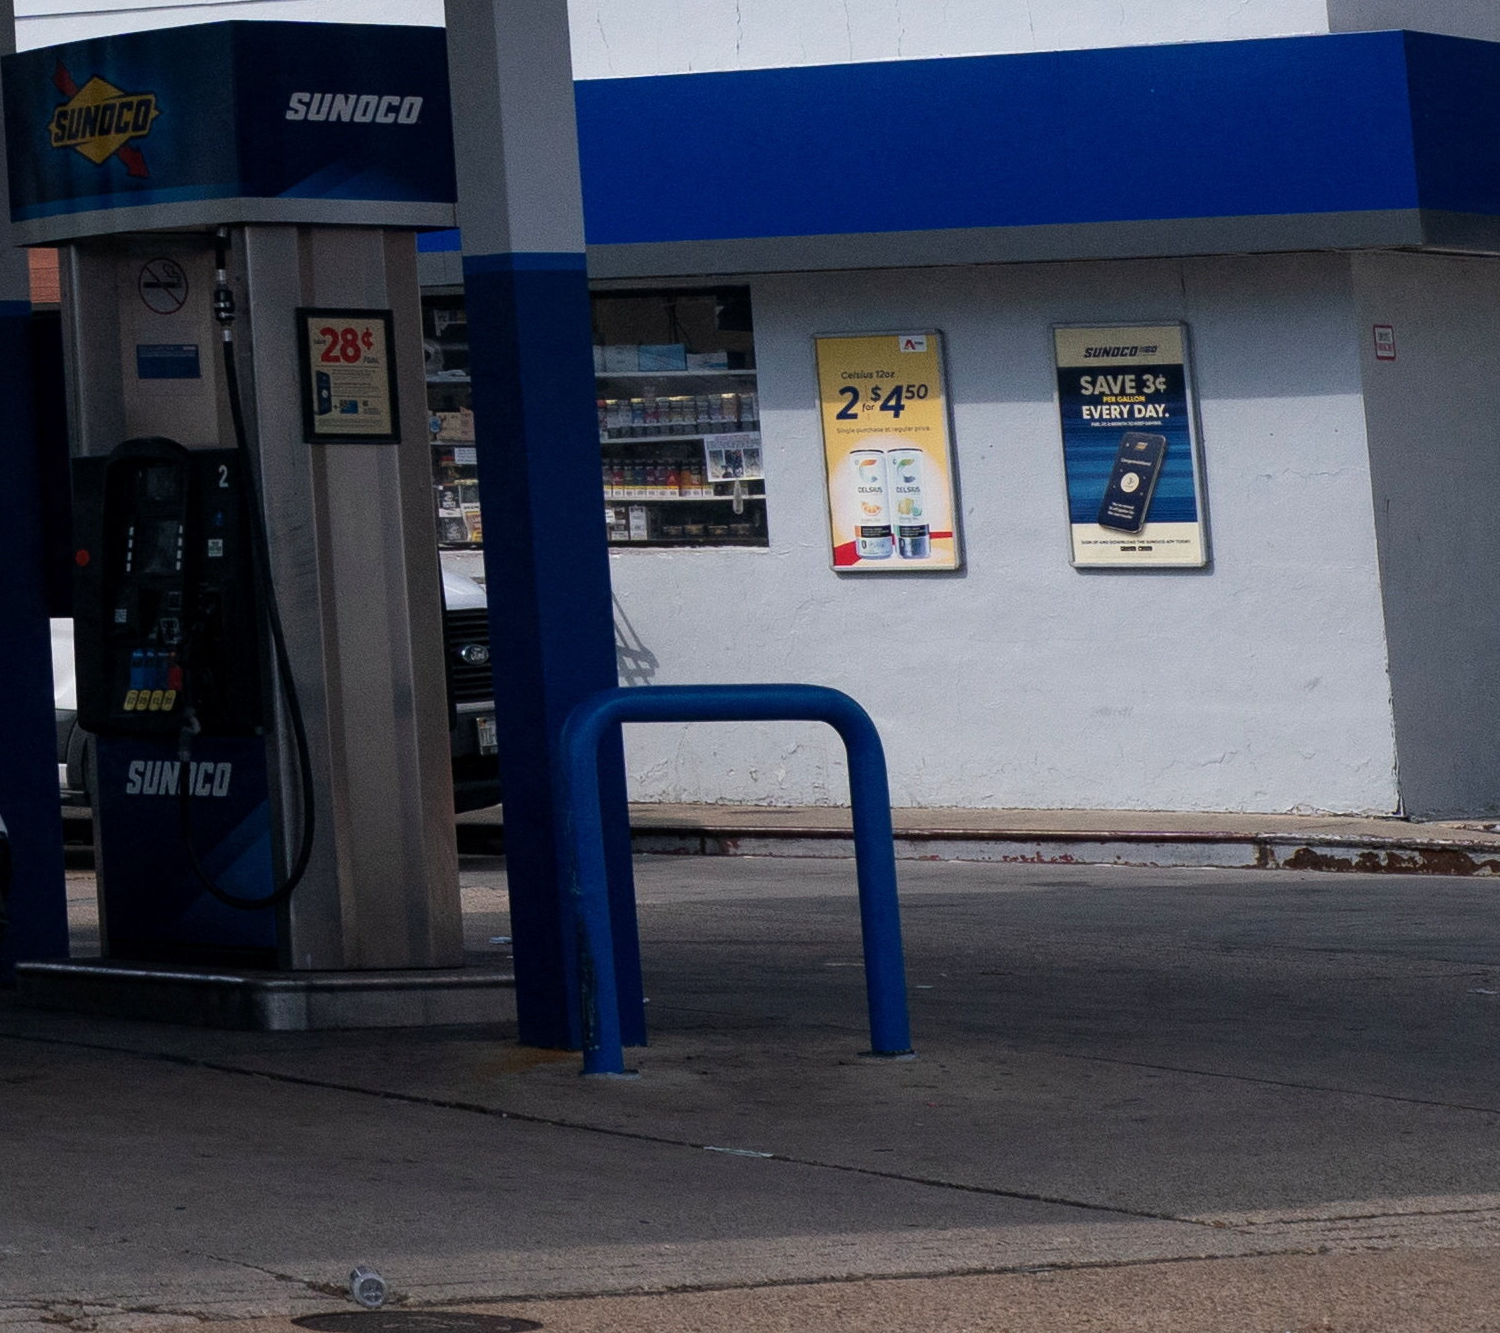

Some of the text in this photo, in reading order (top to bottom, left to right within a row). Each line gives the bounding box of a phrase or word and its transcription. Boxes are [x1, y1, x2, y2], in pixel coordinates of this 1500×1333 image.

[285, 91, 423, 126] SUNOCO
[53, 98, 153, 144] SUNOCO
[1084, 346, 1138, 358] SUNOCO
[841, 370, 874, 380] Celsius
[1080, 374, 1167, 396] SAVE 3¢
[836, 386, 860, 421] 2
[861, 402, 876, 413] for
[1082, 404, 1170, 420] EVERY DAY.
[217, 464, 229, 488] 2
